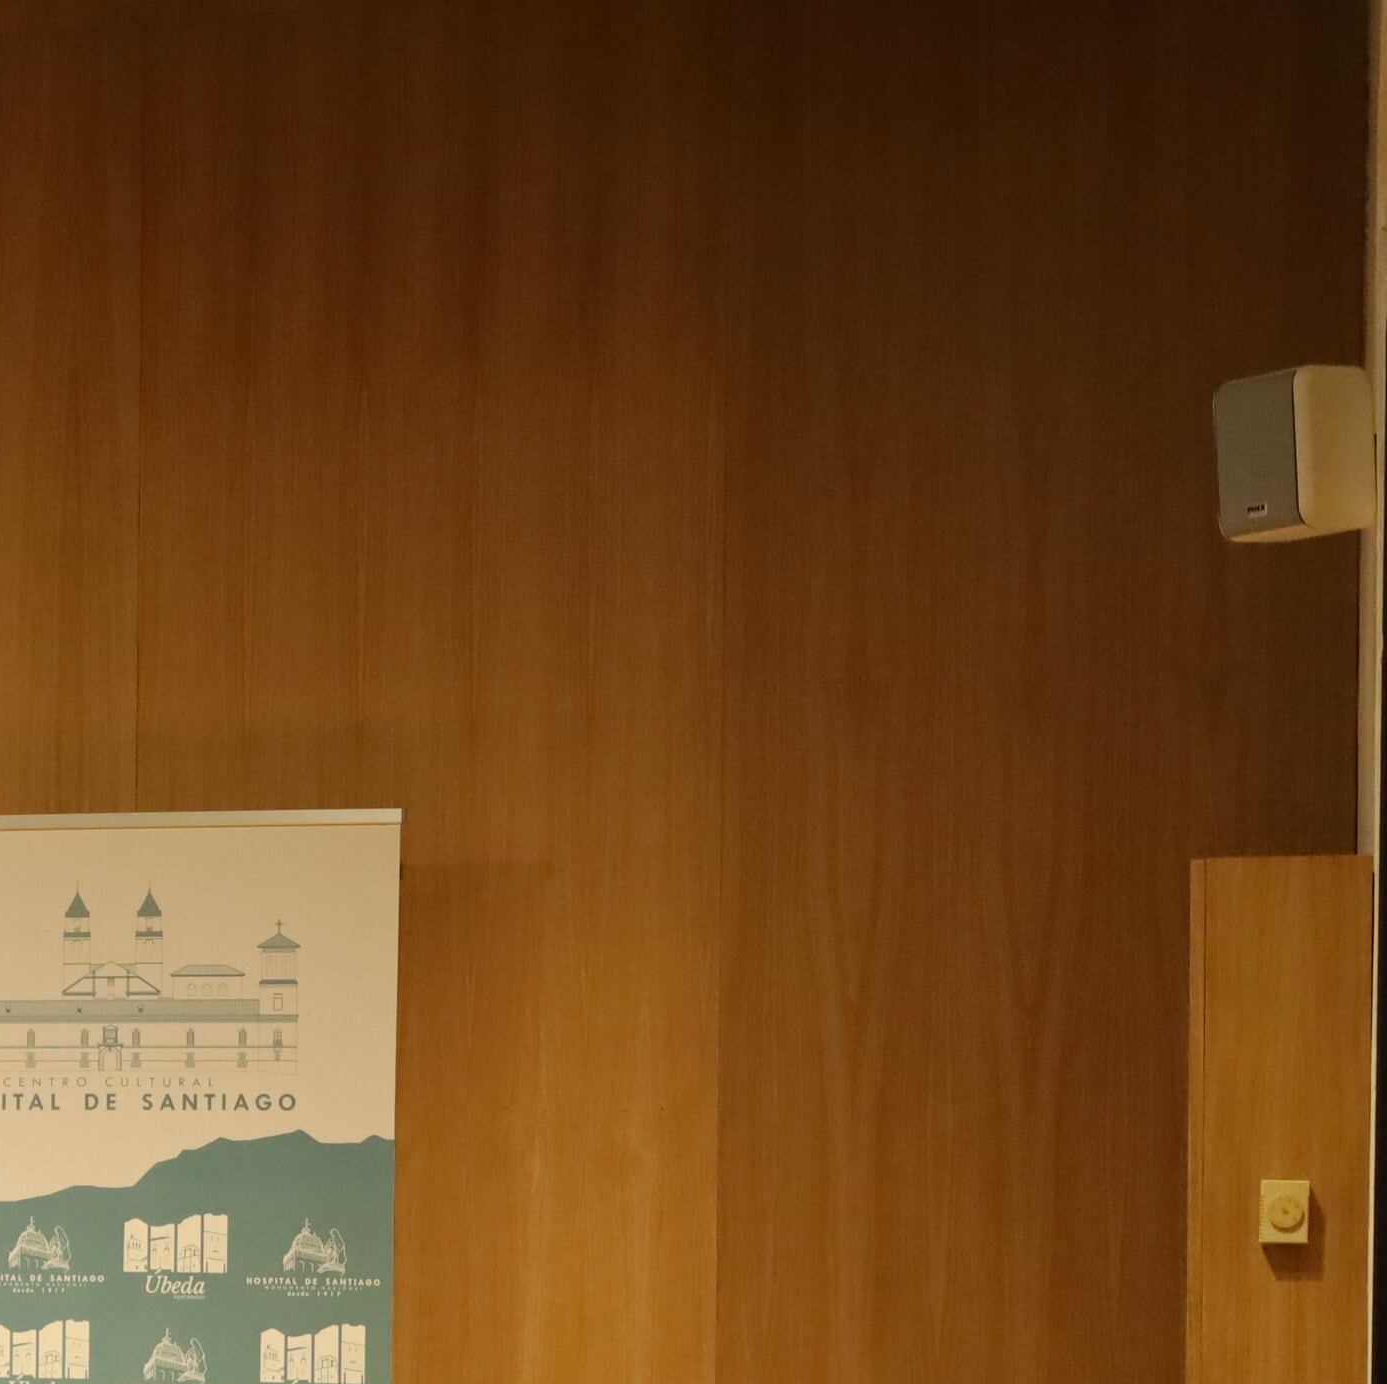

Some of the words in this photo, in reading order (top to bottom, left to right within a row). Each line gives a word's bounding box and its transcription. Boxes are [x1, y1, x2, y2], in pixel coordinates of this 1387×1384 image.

[3, 1076, 87, 1088] CENTRO
[105, 1076, 215, 1088] CULTURAL
[83, 1093, 117, 1112] DE
[141, 1093, 297, 1112] SANTIAGO
[29, 1274, 43, 1282] DE
[50, 1274, 105, 1283] SANTIAGO
[145, 1269, 206, 1295] Úbeda
[246, 1277, 299, 1286] HOSPITAL
[305, 1278, 318, 1286] DE
[325, 1278, 381, 1287] SANTIAGO
